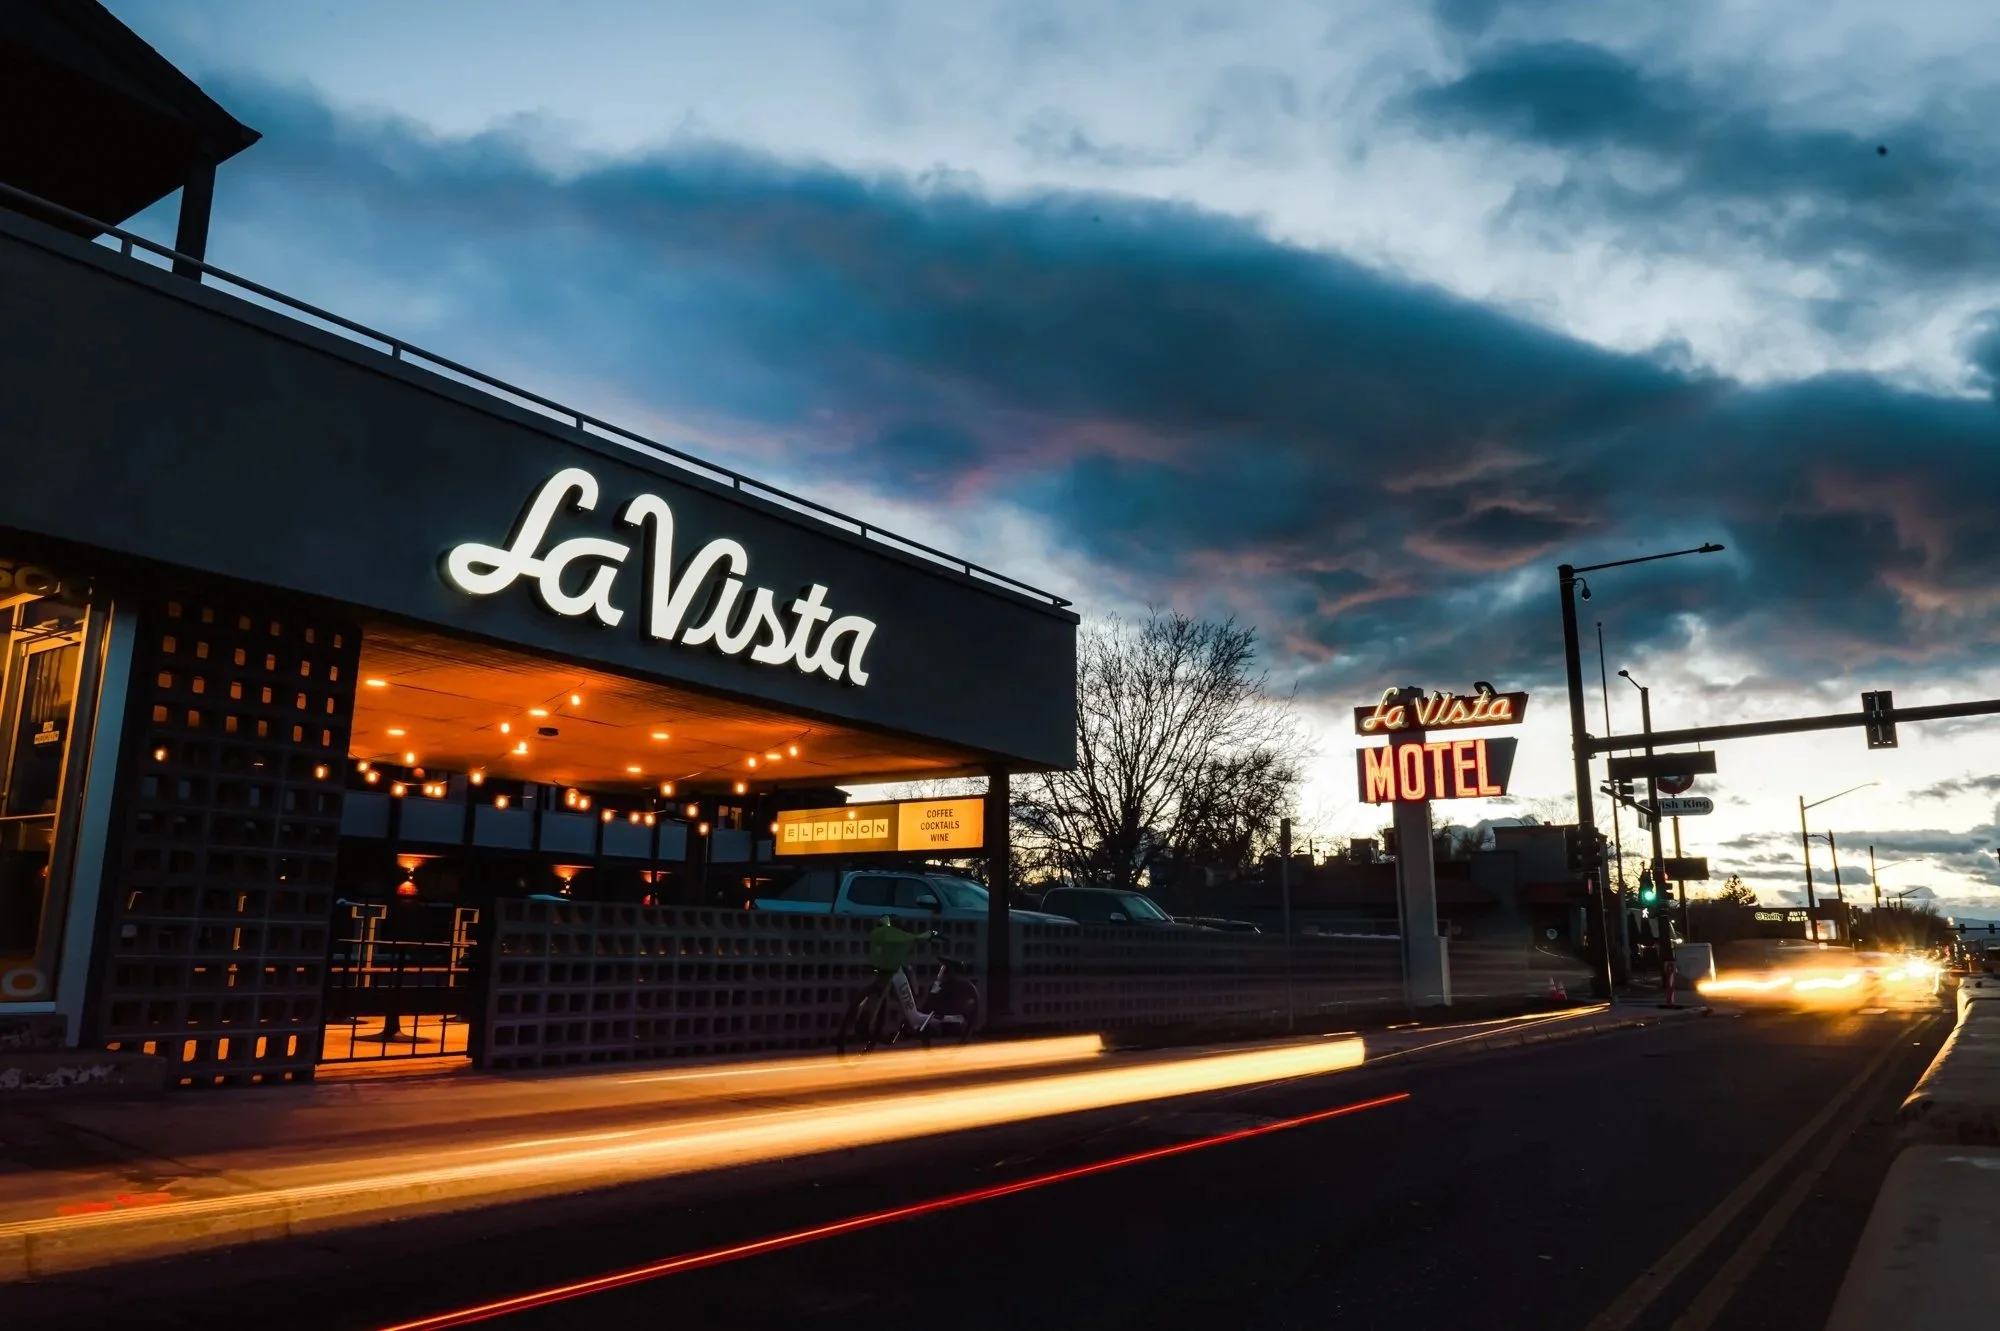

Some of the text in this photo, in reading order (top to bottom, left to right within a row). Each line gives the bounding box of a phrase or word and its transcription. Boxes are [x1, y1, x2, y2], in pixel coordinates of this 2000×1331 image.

[448, 467, 877, 687] La Vista
[1360, 686, 1513, 731] La Vista
[1363, 739, 1502, 803] MOTEL
[1683, 799, 1710, 809] King
[926, 808, 954, 818] COFFEE
[920, 820, 960, 831] COCKTAILS
[930, 832, 949, 842] WINE
